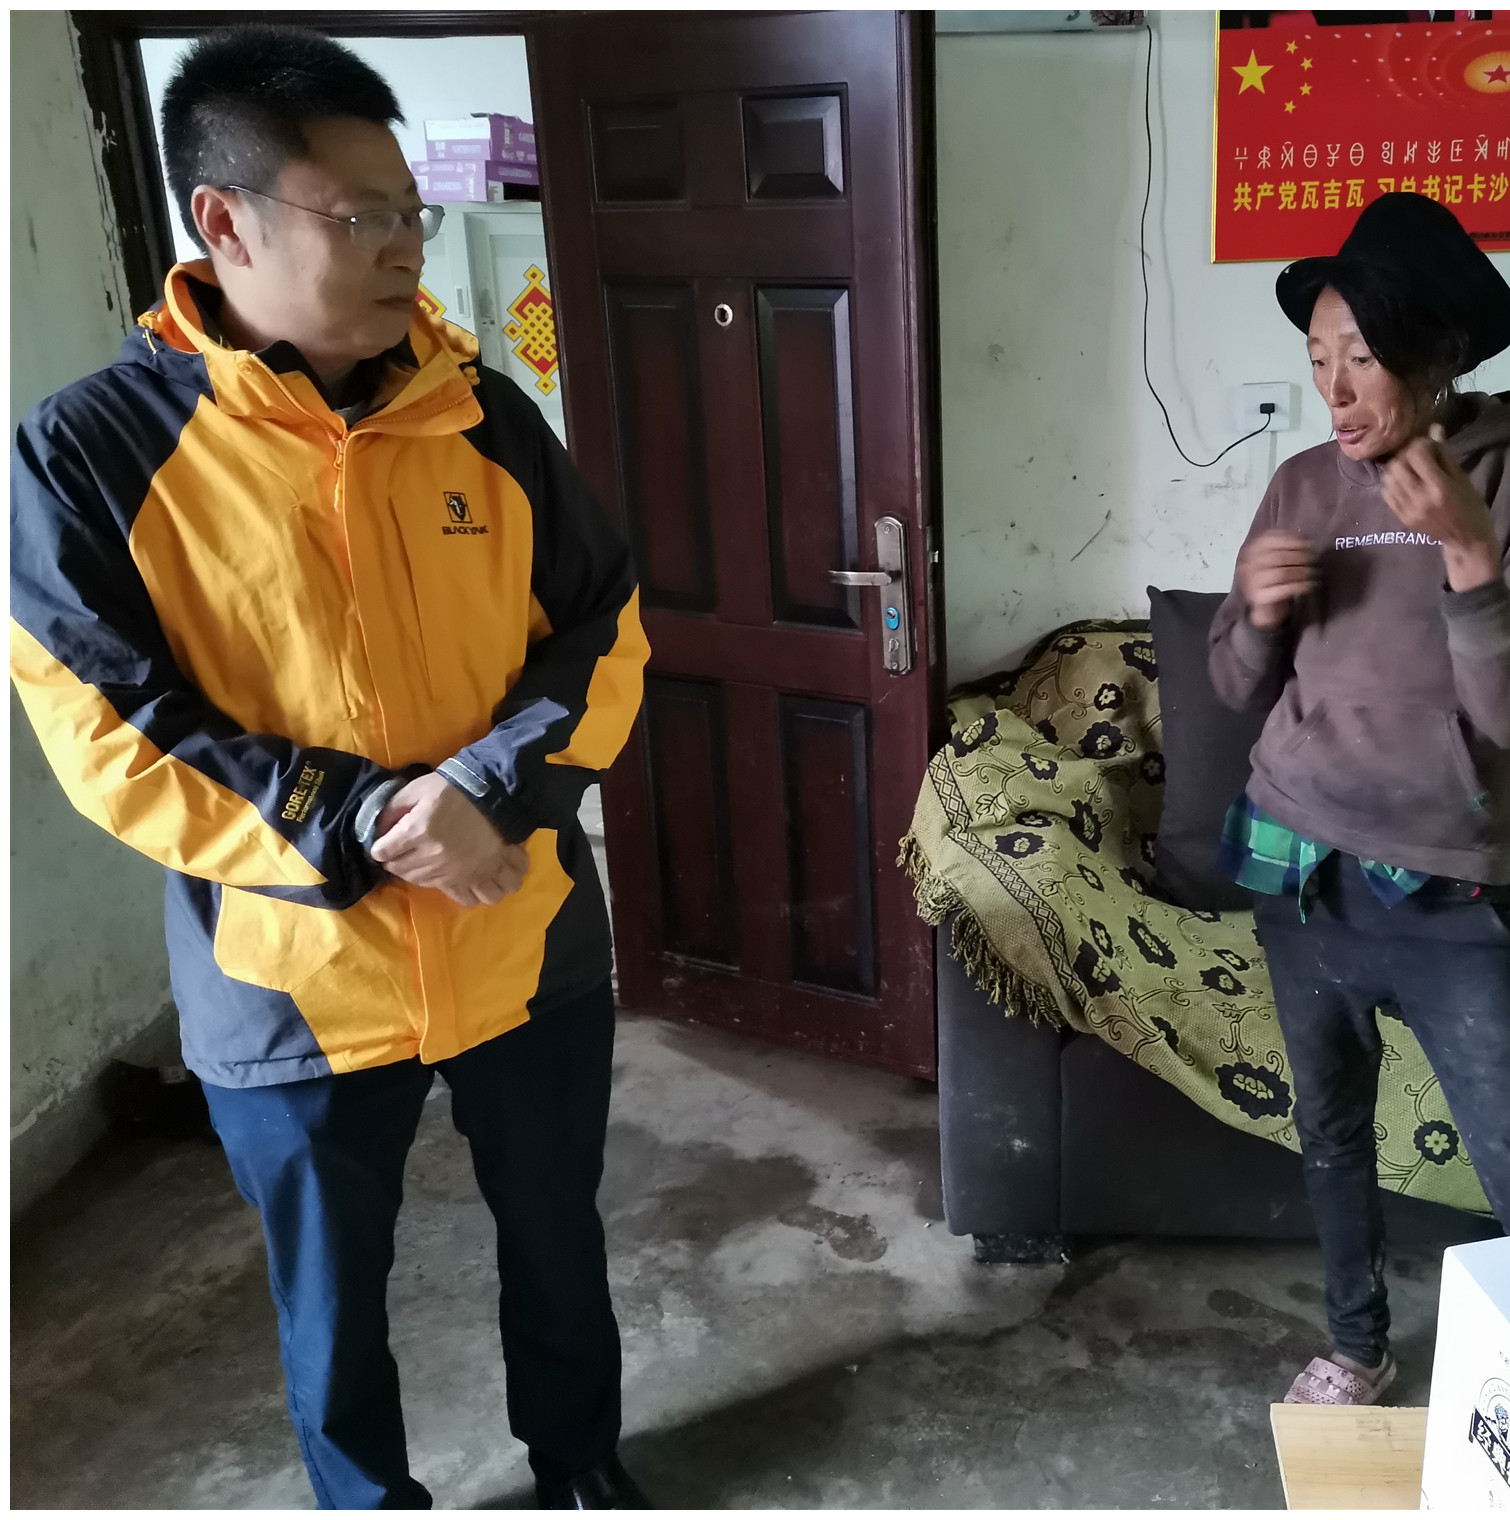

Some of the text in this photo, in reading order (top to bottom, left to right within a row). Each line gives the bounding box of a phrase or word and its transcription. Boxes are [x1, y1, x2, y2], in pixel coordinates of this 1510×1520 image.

[1233, 179, 1365, 211] 共产党瓦吉瓦
[1335, 531, 1445, 551] REMEMBRANC
